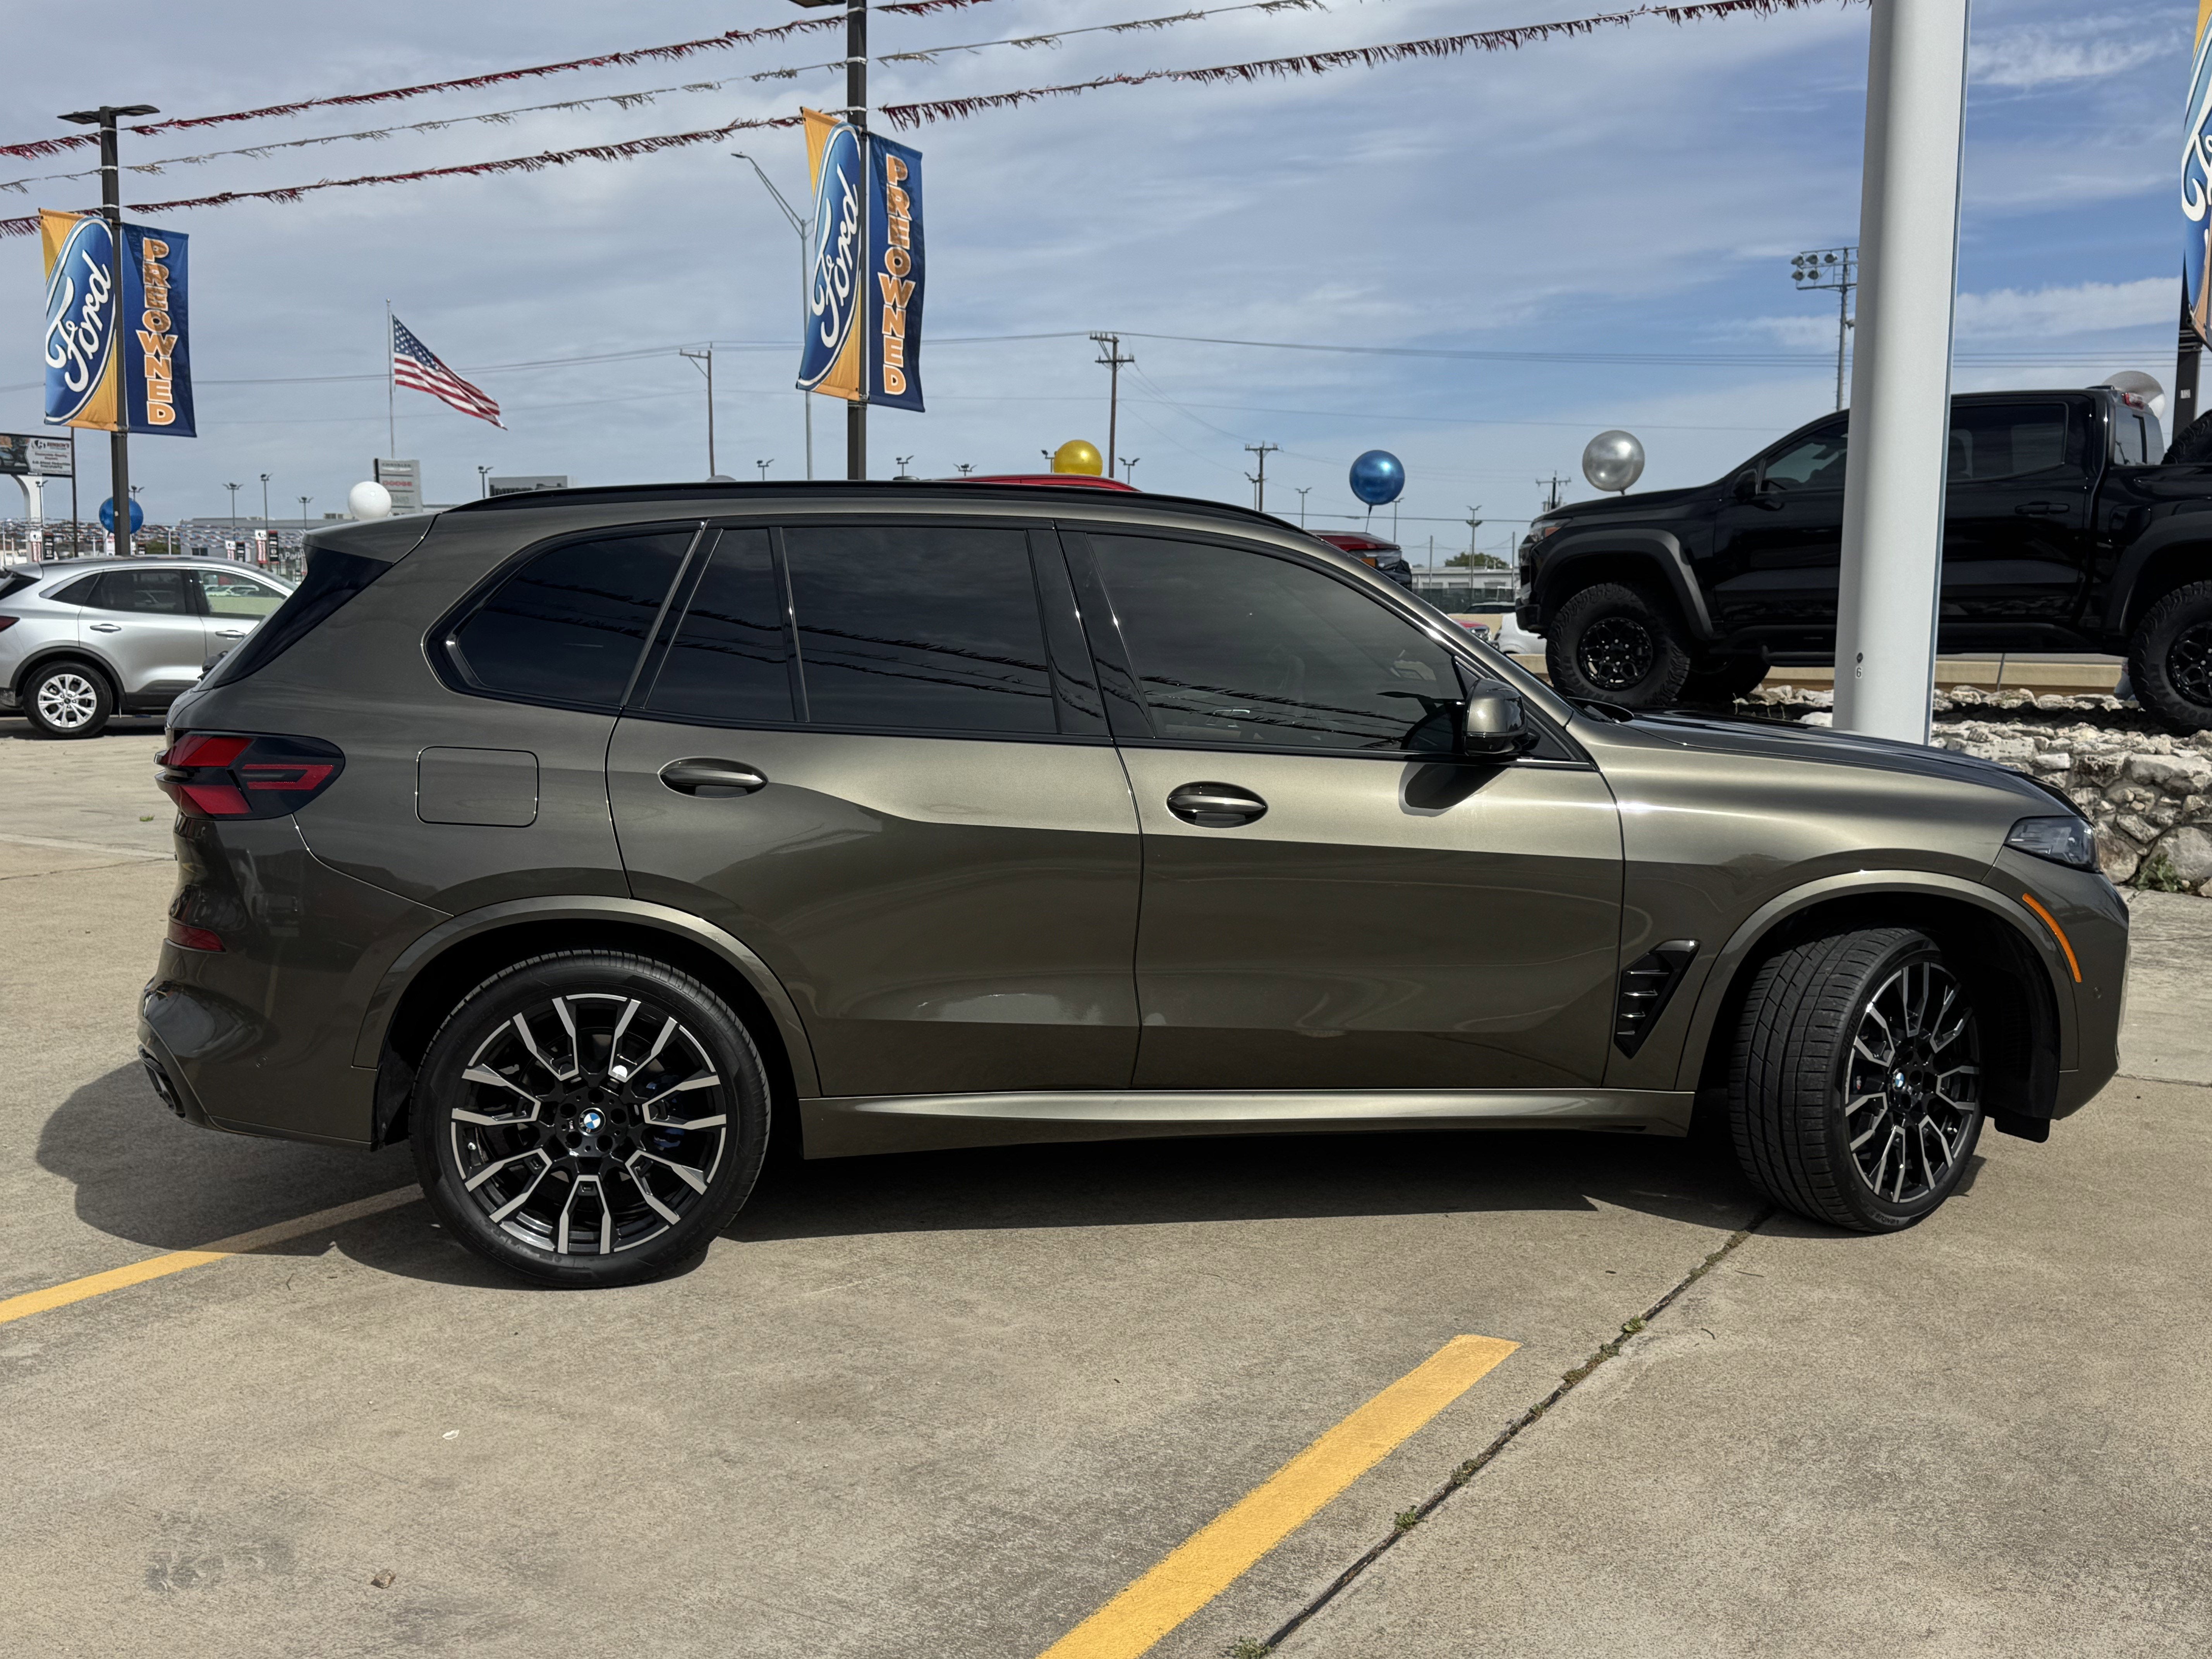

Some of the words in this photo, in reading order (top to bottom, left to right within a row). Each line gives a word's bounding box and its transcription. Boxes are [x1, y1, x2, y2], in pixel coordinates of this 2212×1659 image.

[45, 249, 112, 393] Ford
[811, 164, 859, 348] Ford
[1856, 667, 1862, 678] 6
